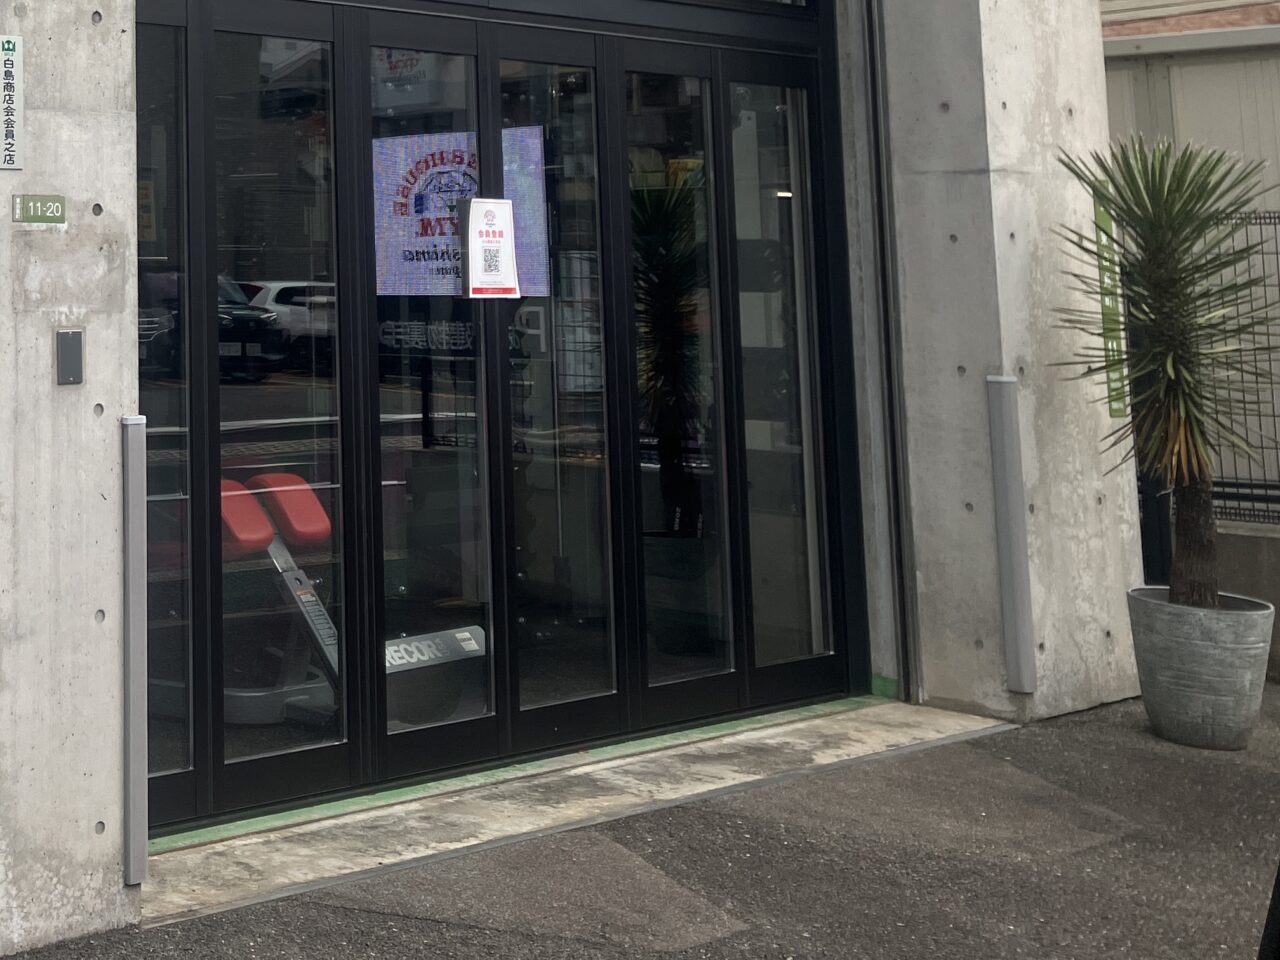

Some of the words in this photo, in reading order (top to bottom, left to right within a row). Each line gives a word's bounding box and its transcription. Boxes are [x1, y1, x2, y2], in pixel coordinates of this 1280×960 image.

[2, 57, 17, 166] 白島商店会会員之店
[28, 201, 62, 217] 11-20
